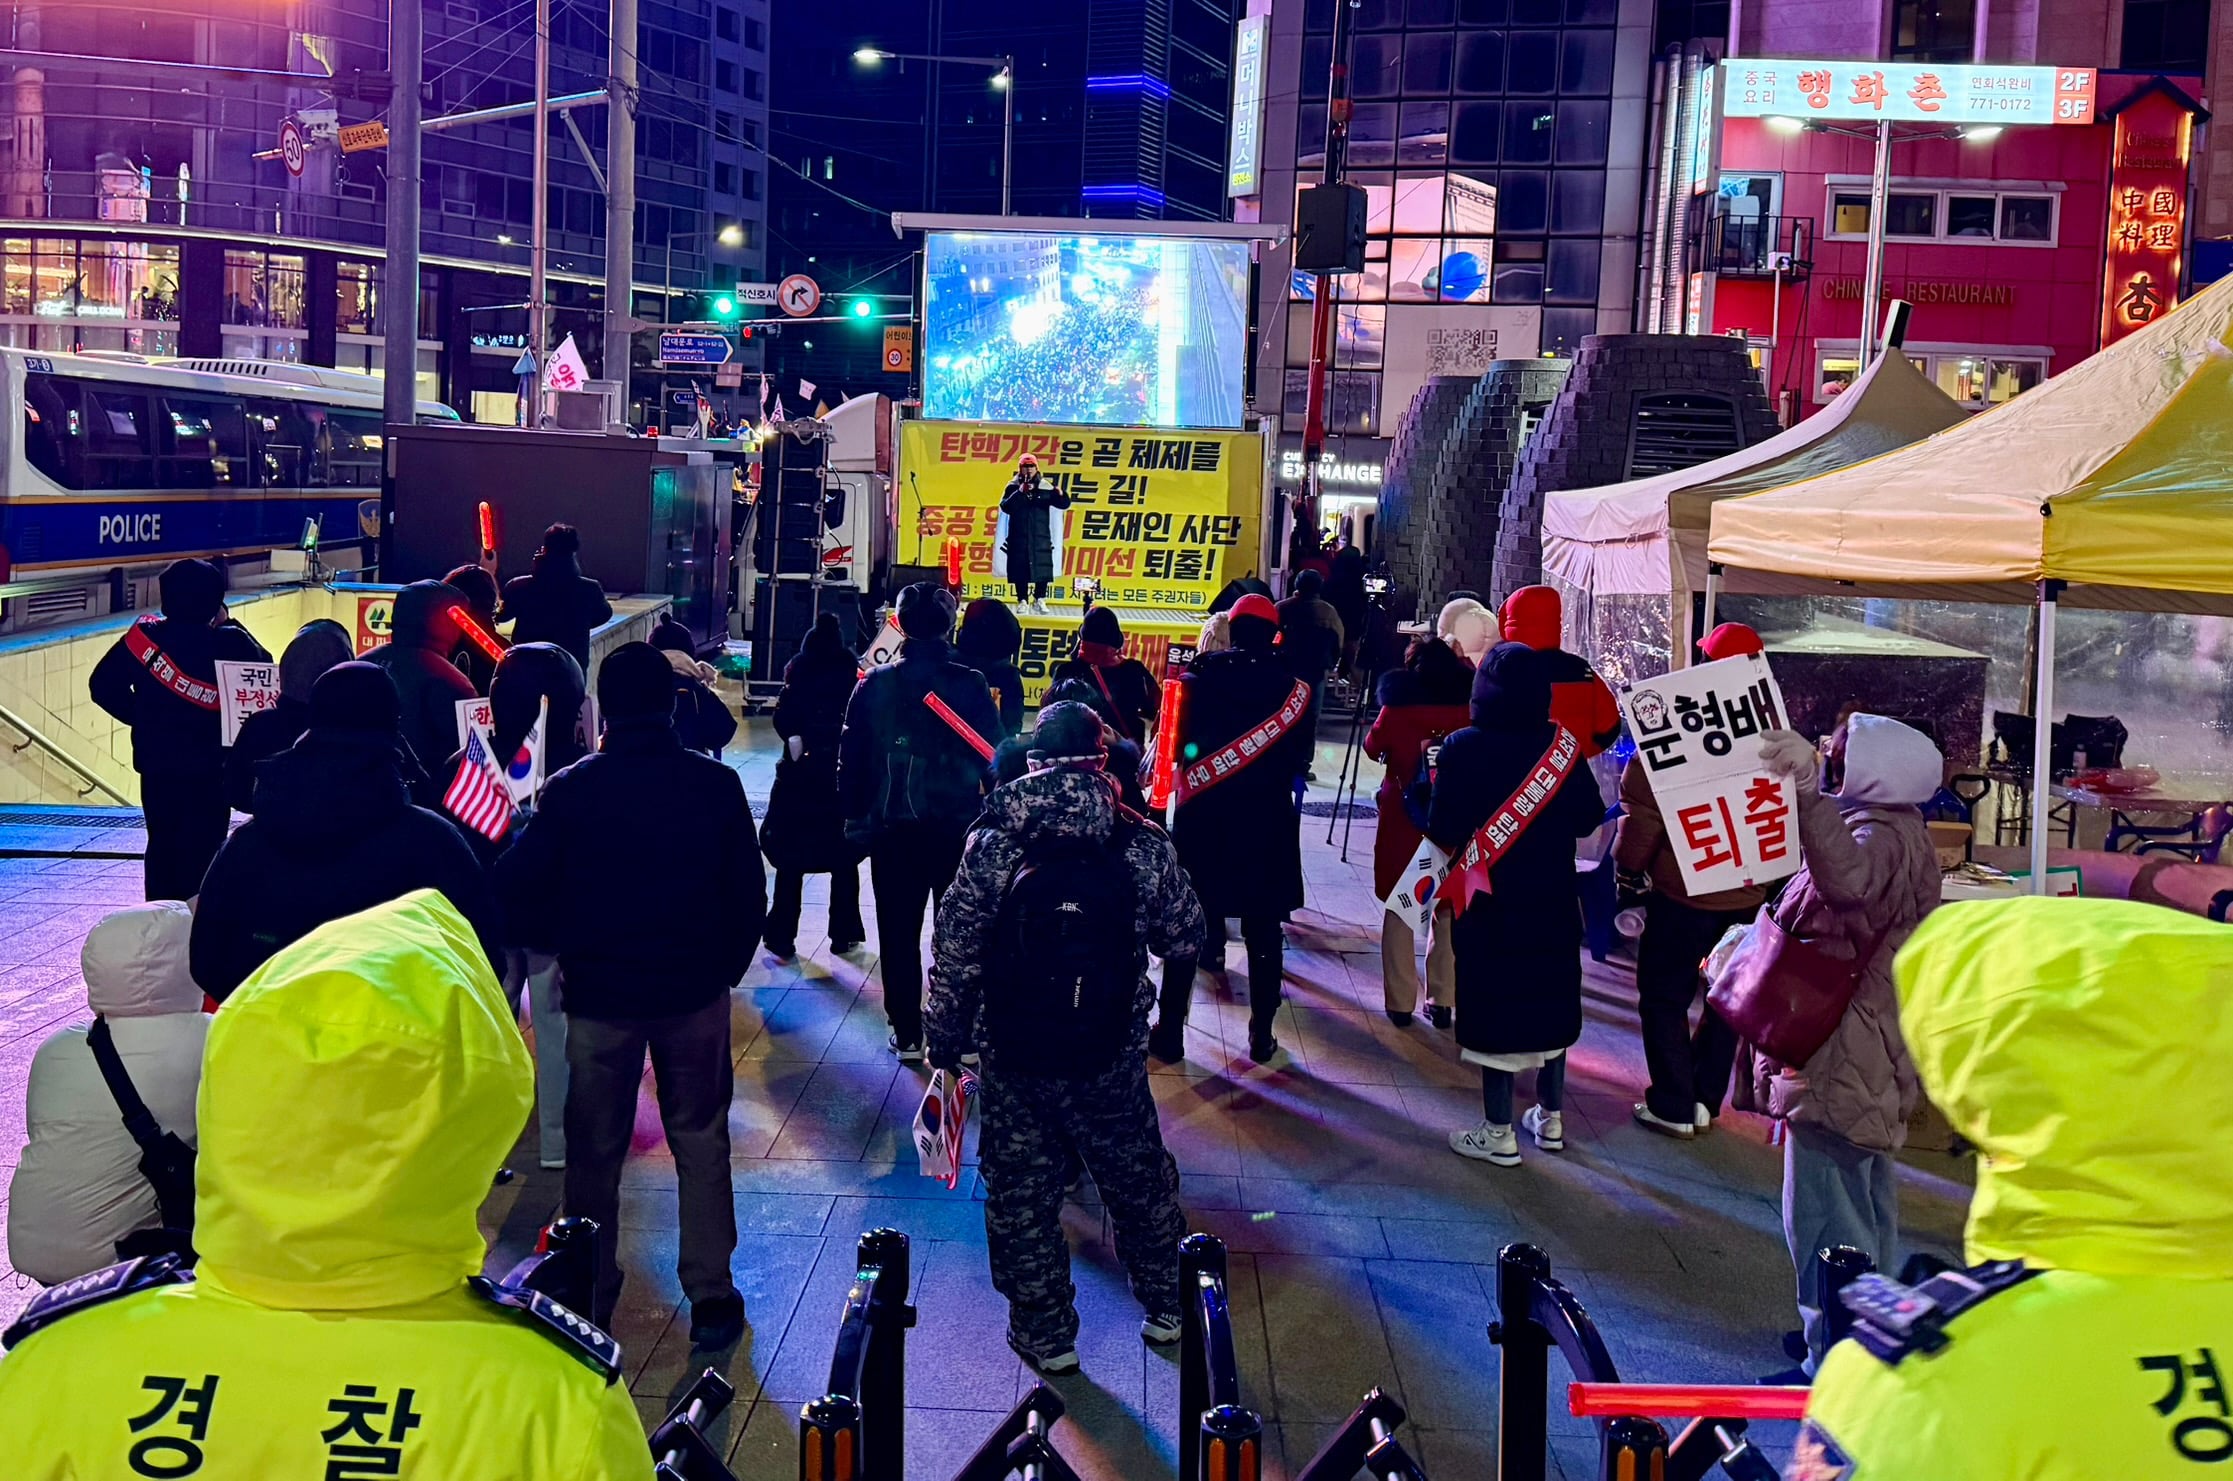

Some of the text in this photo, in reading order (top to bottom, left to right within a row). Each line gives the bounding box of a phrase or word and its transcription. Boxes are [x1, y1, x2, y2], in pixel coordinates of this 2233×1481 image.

[1745, 71, 1777, 86] 중국
[1797, 70, 1947, 112] 행화촌
[1971, 77, 2031, 90] 연회석완비
[2061, 72, 2090, 91] 2F
[1744, 90, 1776, 104] 요리
[1970, 98, 2031, 110] 771-0172
[2058, 99, 2088, 118] 3F
[1234, 60, 1255, 170] 머니박스
[285, 137, 300, 162] 50
[2122, 190, 2175, 215] 中國
[2120, 223, 2174, 248] 料理
[737, 288, 776, 300] 적신호시
[1823, 280, 2016, 304] CHINE RESTAURANT
[2115, 275, 2160, 321] 杏
[890, 353, 899, 362] 30
[940, 432, 1221, 471] 탄핵기각은 곧 체제를
[1283, 463, 1381, 480] EXHANGE
[1108, 474, 1148, 504] 길!
[99, 514, 161, 544] POLICE
[916, 505, 976, 536] 중공
[1082, 510, 1172, 542] 문재인
[1178, 514, 1241, 545] 사단
[1142, 549, 1216, 581] 퇴출!
[982, 584, 1006, 598] 법과
[1123, 589, 1147, 602] 모든
[1152, 590, 1207, 604] 주권자들)
[174, 676, 217, 703] 대통령
[241, 668, 272, 687] 국민
[1239, 720, 1281, 756] 대통령
[1211, 748, 1240, 775] 탄핵
[1513, 766, 1557, 817] 대통령
[1485, 812, 1519, 850] 탄핵
[1677, 777, 1789, 872] 퇴출
[2137, 1347, 2233, 1462] 경
[128, 1374, 422, 1481] 경찰
